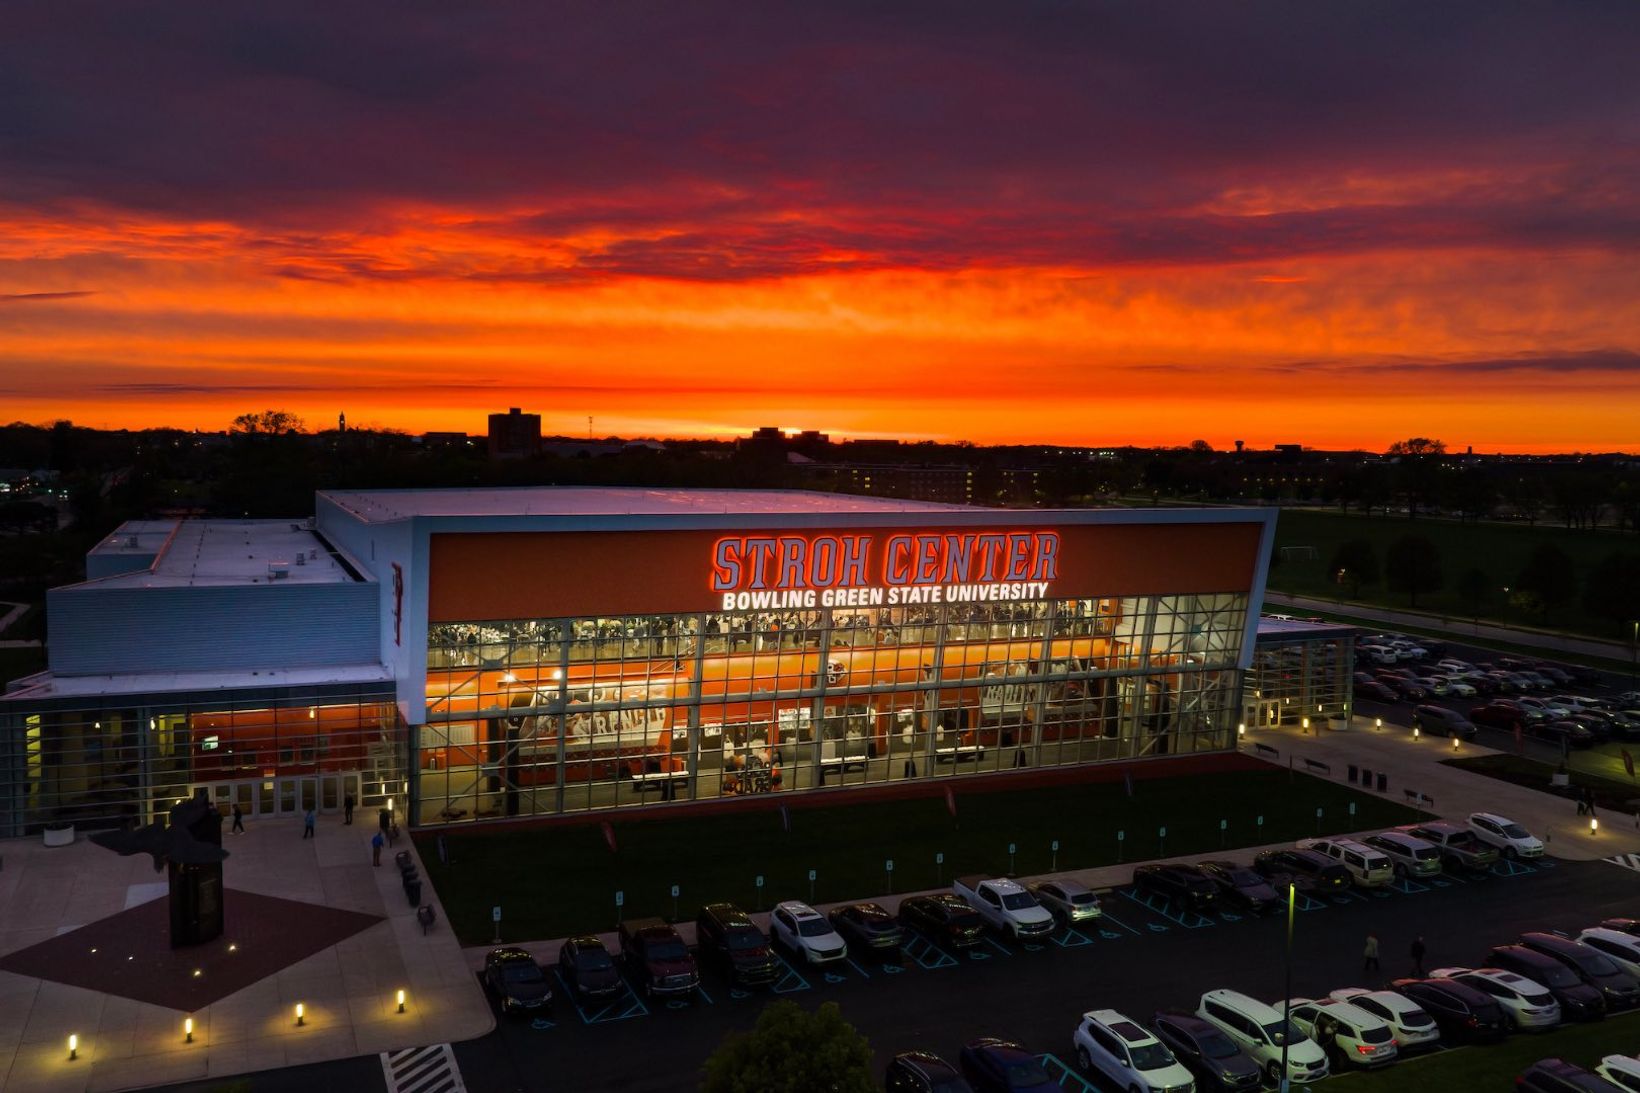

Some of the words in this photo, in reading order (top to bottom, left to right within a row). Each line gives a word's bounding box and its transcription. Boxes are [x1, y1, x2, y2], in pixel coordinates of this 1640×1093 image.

[713, 536, 873, 590] STROH
[885, 533, 1060, 585] CENTER
[722, 590, 816, 611] BOWLING
[821, 587, 884, 607] GREEN
[887, 585, 942, 605] STATE
[946, 582, 1049, 603] UNIVERSITY
